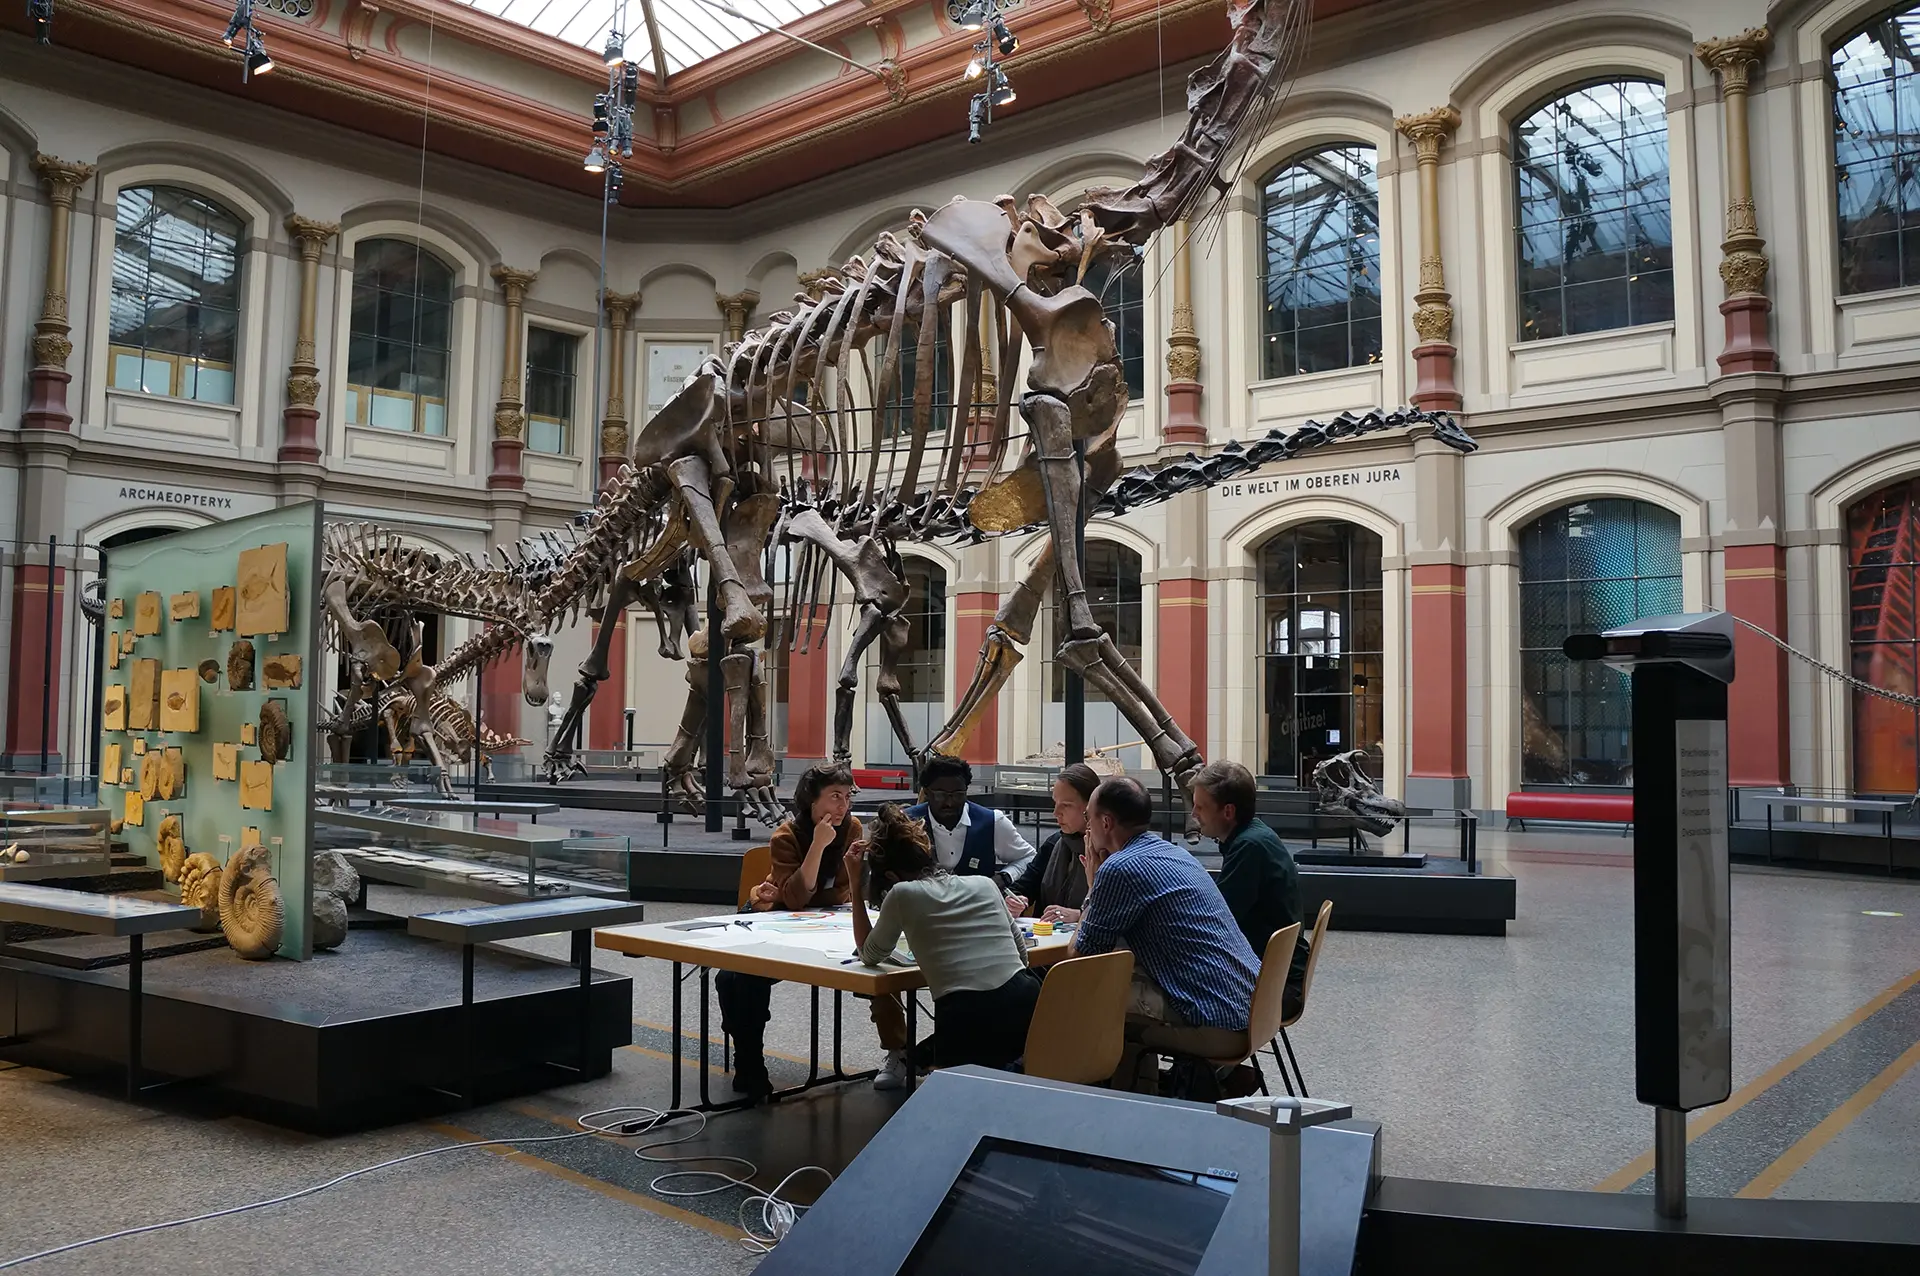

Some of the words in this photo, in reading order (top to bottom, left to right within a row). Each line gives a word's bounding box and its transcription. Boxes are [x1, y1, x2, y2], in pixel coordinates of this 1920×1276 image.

[1222, 486, 1242, 497] DIE
[1248, 481, 1279, 495] WELT
[1285, 479, 1300, 491] IM
[1306, 473, 1360, 489] OBEREN
[1366, 468, 1401, 484] JURA
[119, 487, 232, 508] ARCHAEOPTERYX
[1281, 709, 1326, 737] digitize!
